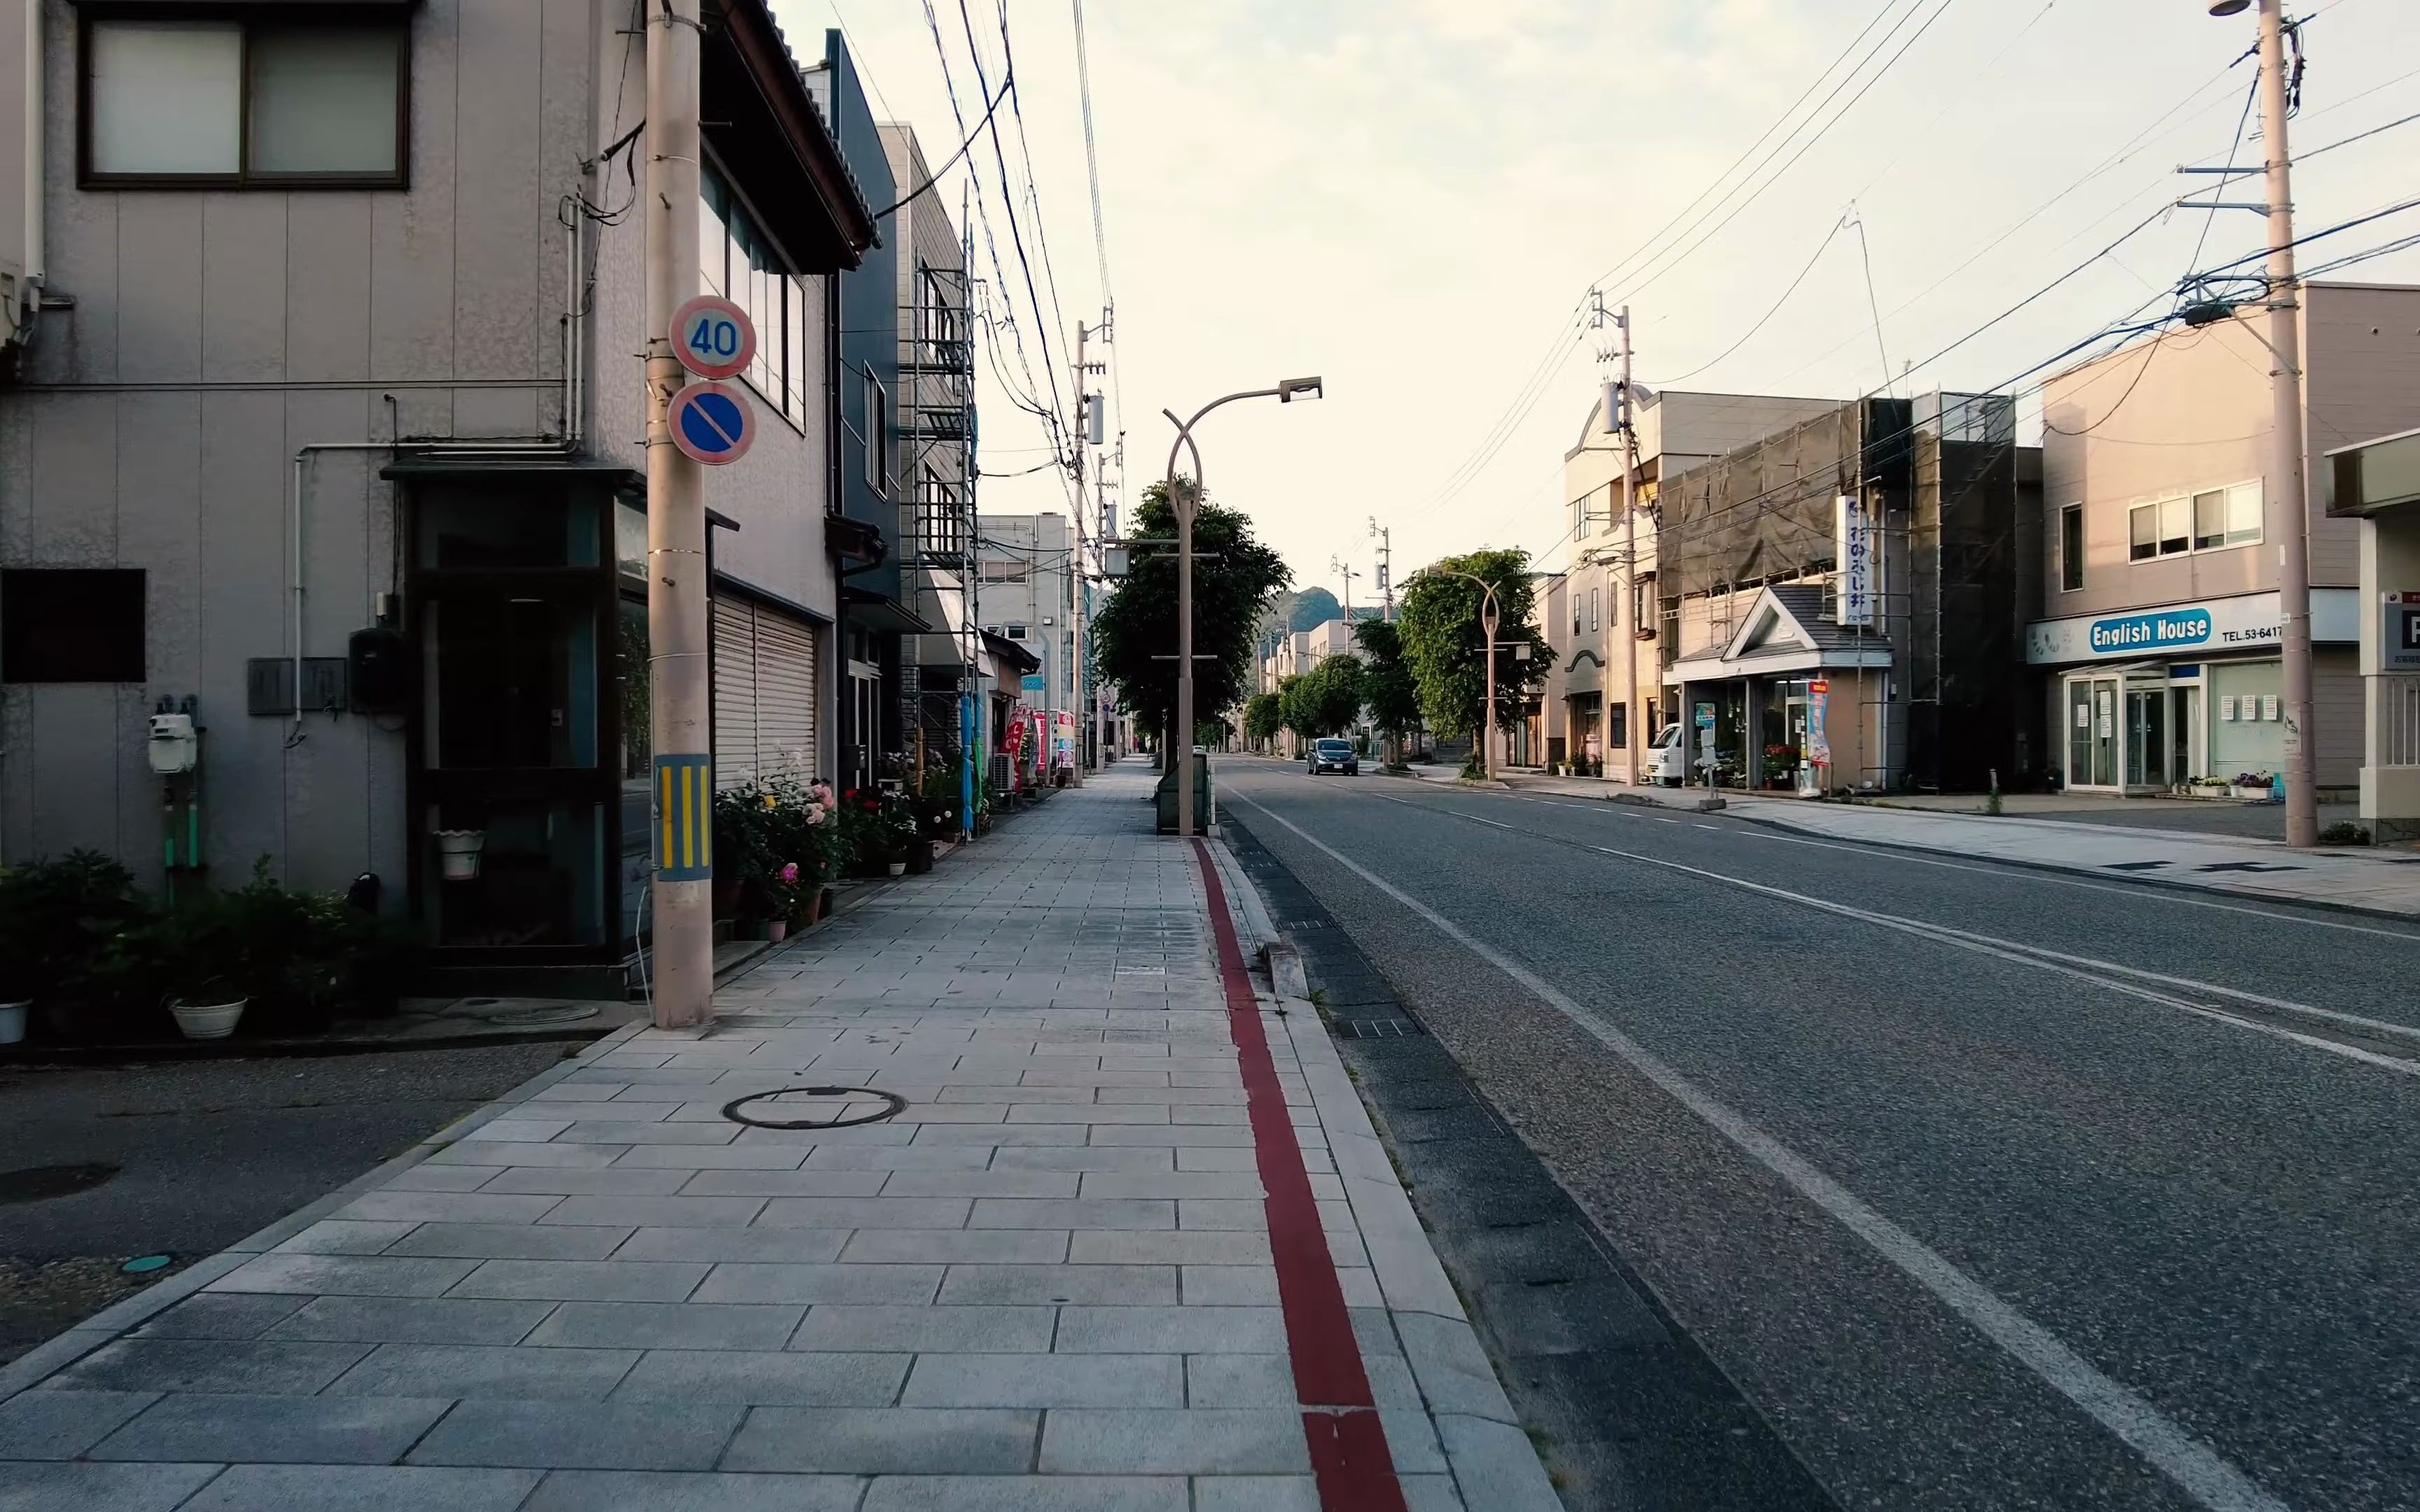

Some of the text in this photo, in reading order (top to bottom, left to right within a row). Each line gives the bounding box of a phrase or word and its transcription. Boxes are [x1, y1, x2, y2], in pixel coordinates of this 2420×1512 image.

[690, 318, 737, 356] 40
[2093, 621, 2150, 646] English
[2157, 619, 2207, 640] House
